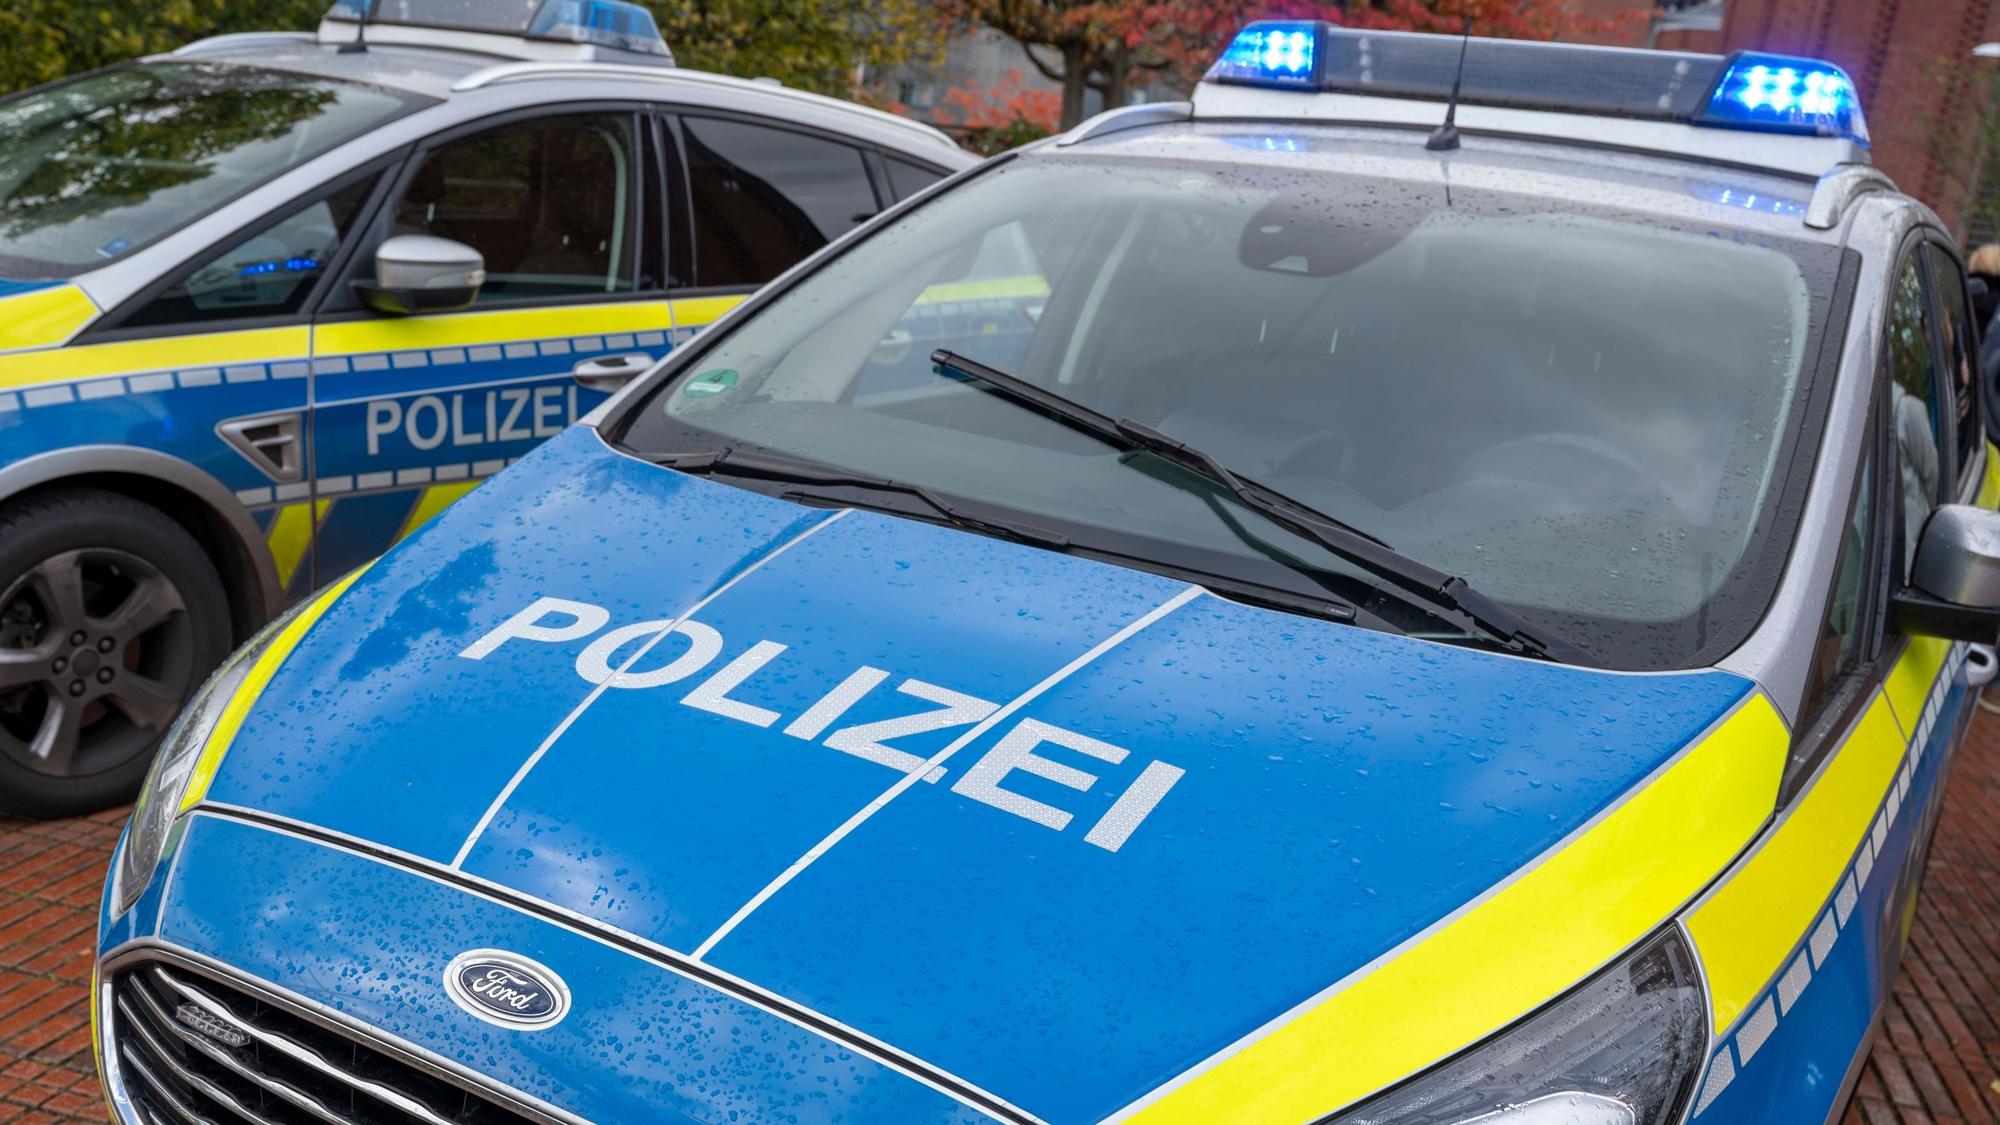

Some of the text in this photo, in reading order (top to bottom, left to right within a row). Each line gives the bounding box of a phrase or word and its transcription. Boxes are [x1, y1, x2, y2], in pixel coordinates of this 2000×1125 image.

[366, 385, 578, 455] POLIZEI
[458, 596, 1186, 852] POLIZEI
[472, 969, 538, 1010] Ford
